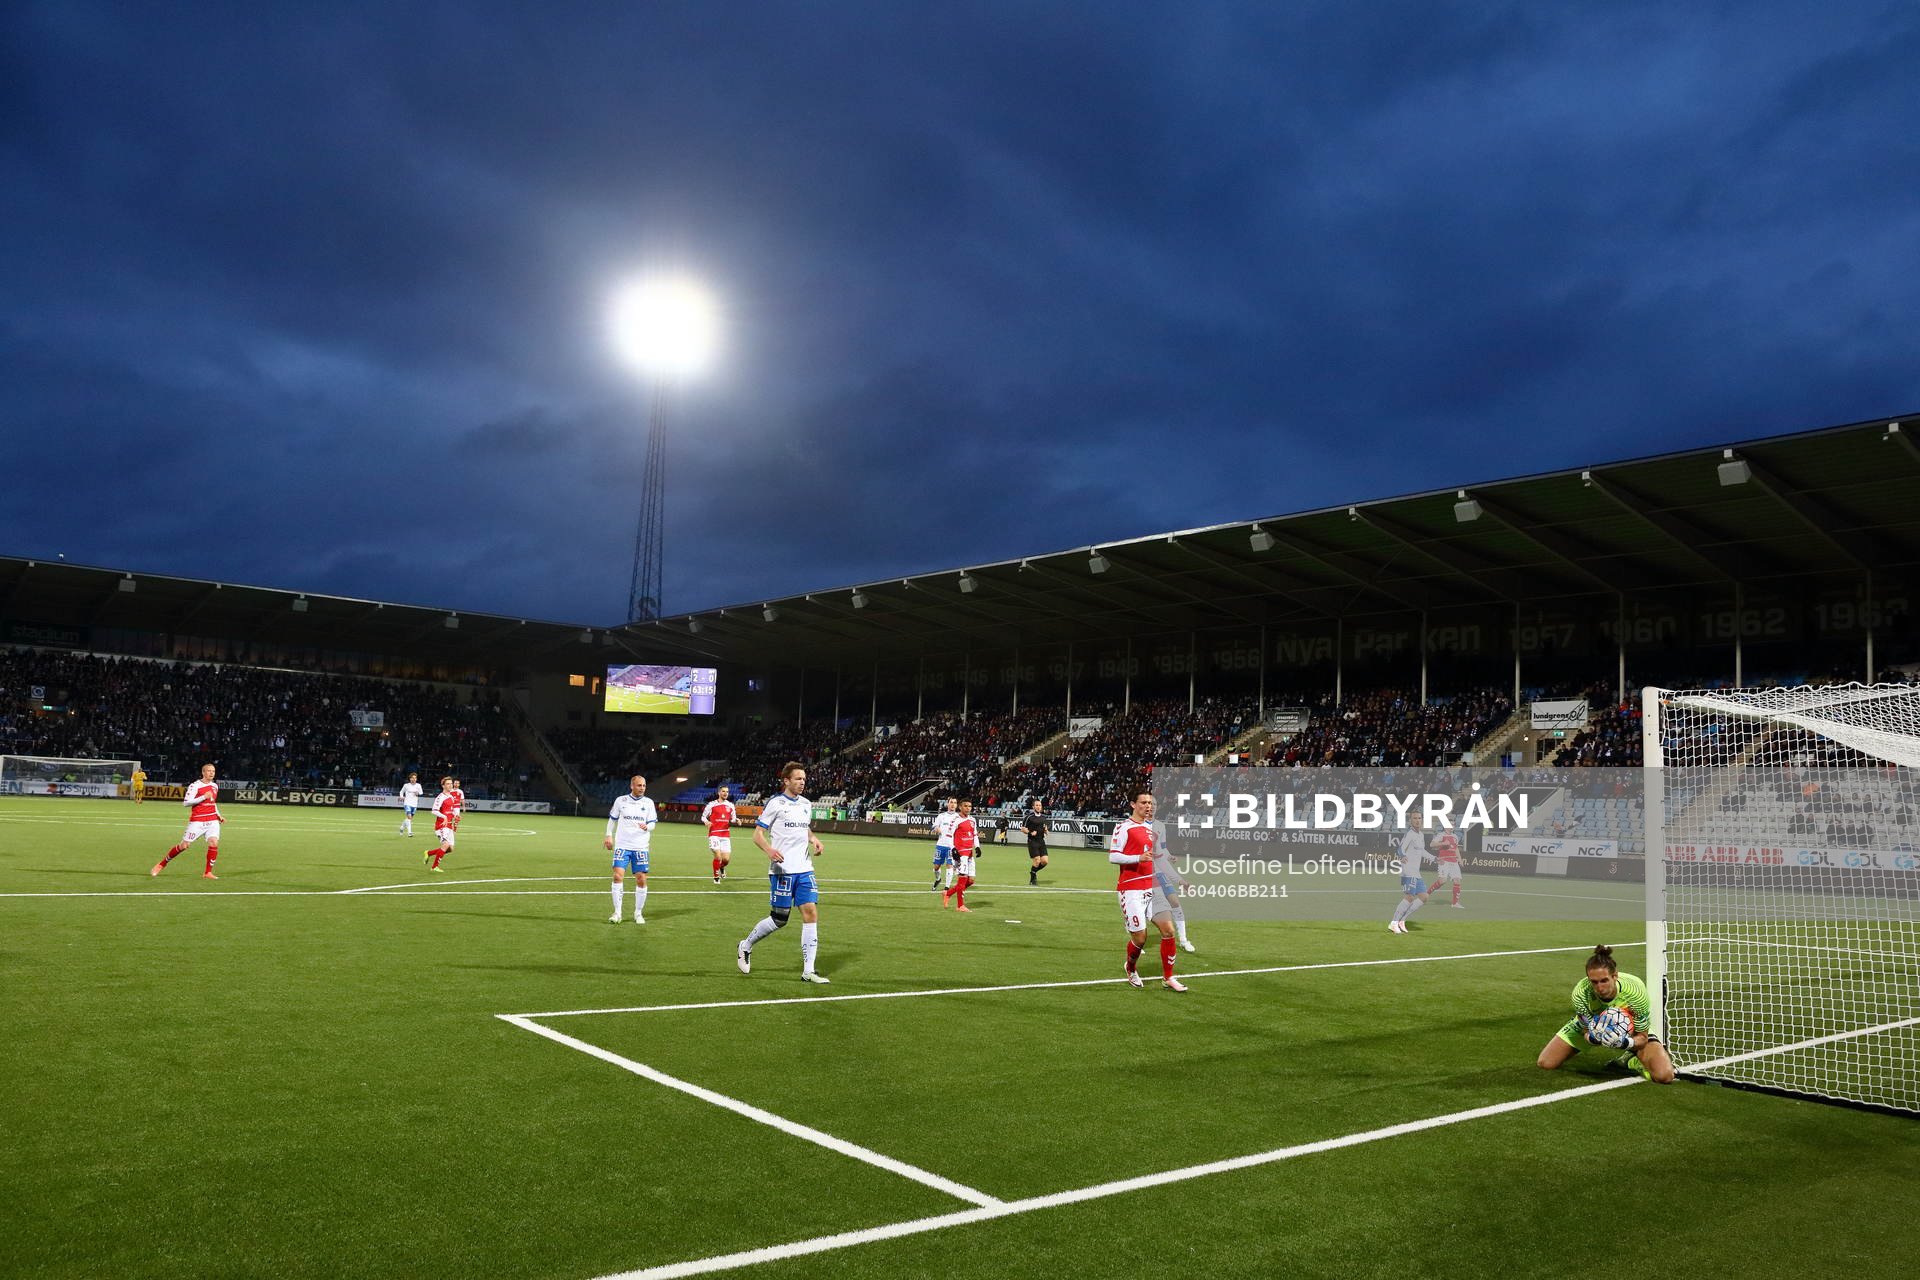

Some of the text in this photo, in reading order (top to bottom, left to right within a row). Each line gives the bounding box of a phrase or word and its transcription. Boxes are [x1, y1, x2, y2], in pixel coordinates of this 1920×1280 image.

[1700, 608, 1786, 638] 1962
[1278, 637, 1332, 666] Nya
[1214, 648, 1260, 670] 1956
[692, 673, 698, 682] 2
[708, 674, 714, 683] 0
[692, 685, 714, 694] 63:15
[75, 784, 100, 793] Smith
[260, 790, 336, 804] XL-BYGG
[978, 820, 997, 828] BUTIK
[1052, 821, 1070, 832] kvm
[1080, 821, 1099, 833] kvm
[1178, 828, 1199, 838] kvm
[1216, 827, 1251, 841] LÄGGER
[1281, 832, 1289, 842] &
[1291, 830, 1325, 845] SÄTTER
[1328, 834, 1359, 846] KAKEL
[1486, 843, 1510, 852] NCC
[1530, 845, 1555, 854] NCC
[1577, 846, 1604, 856] NCC
[1665, 846, 1696, 861] ABB
[1702, 846, 1739, 862] ABB
[1745, 847, 1784, 865] ABB
[1471, 857, 1521, 868] Assemblin.
[1132, 915, 1140, 927] 9
